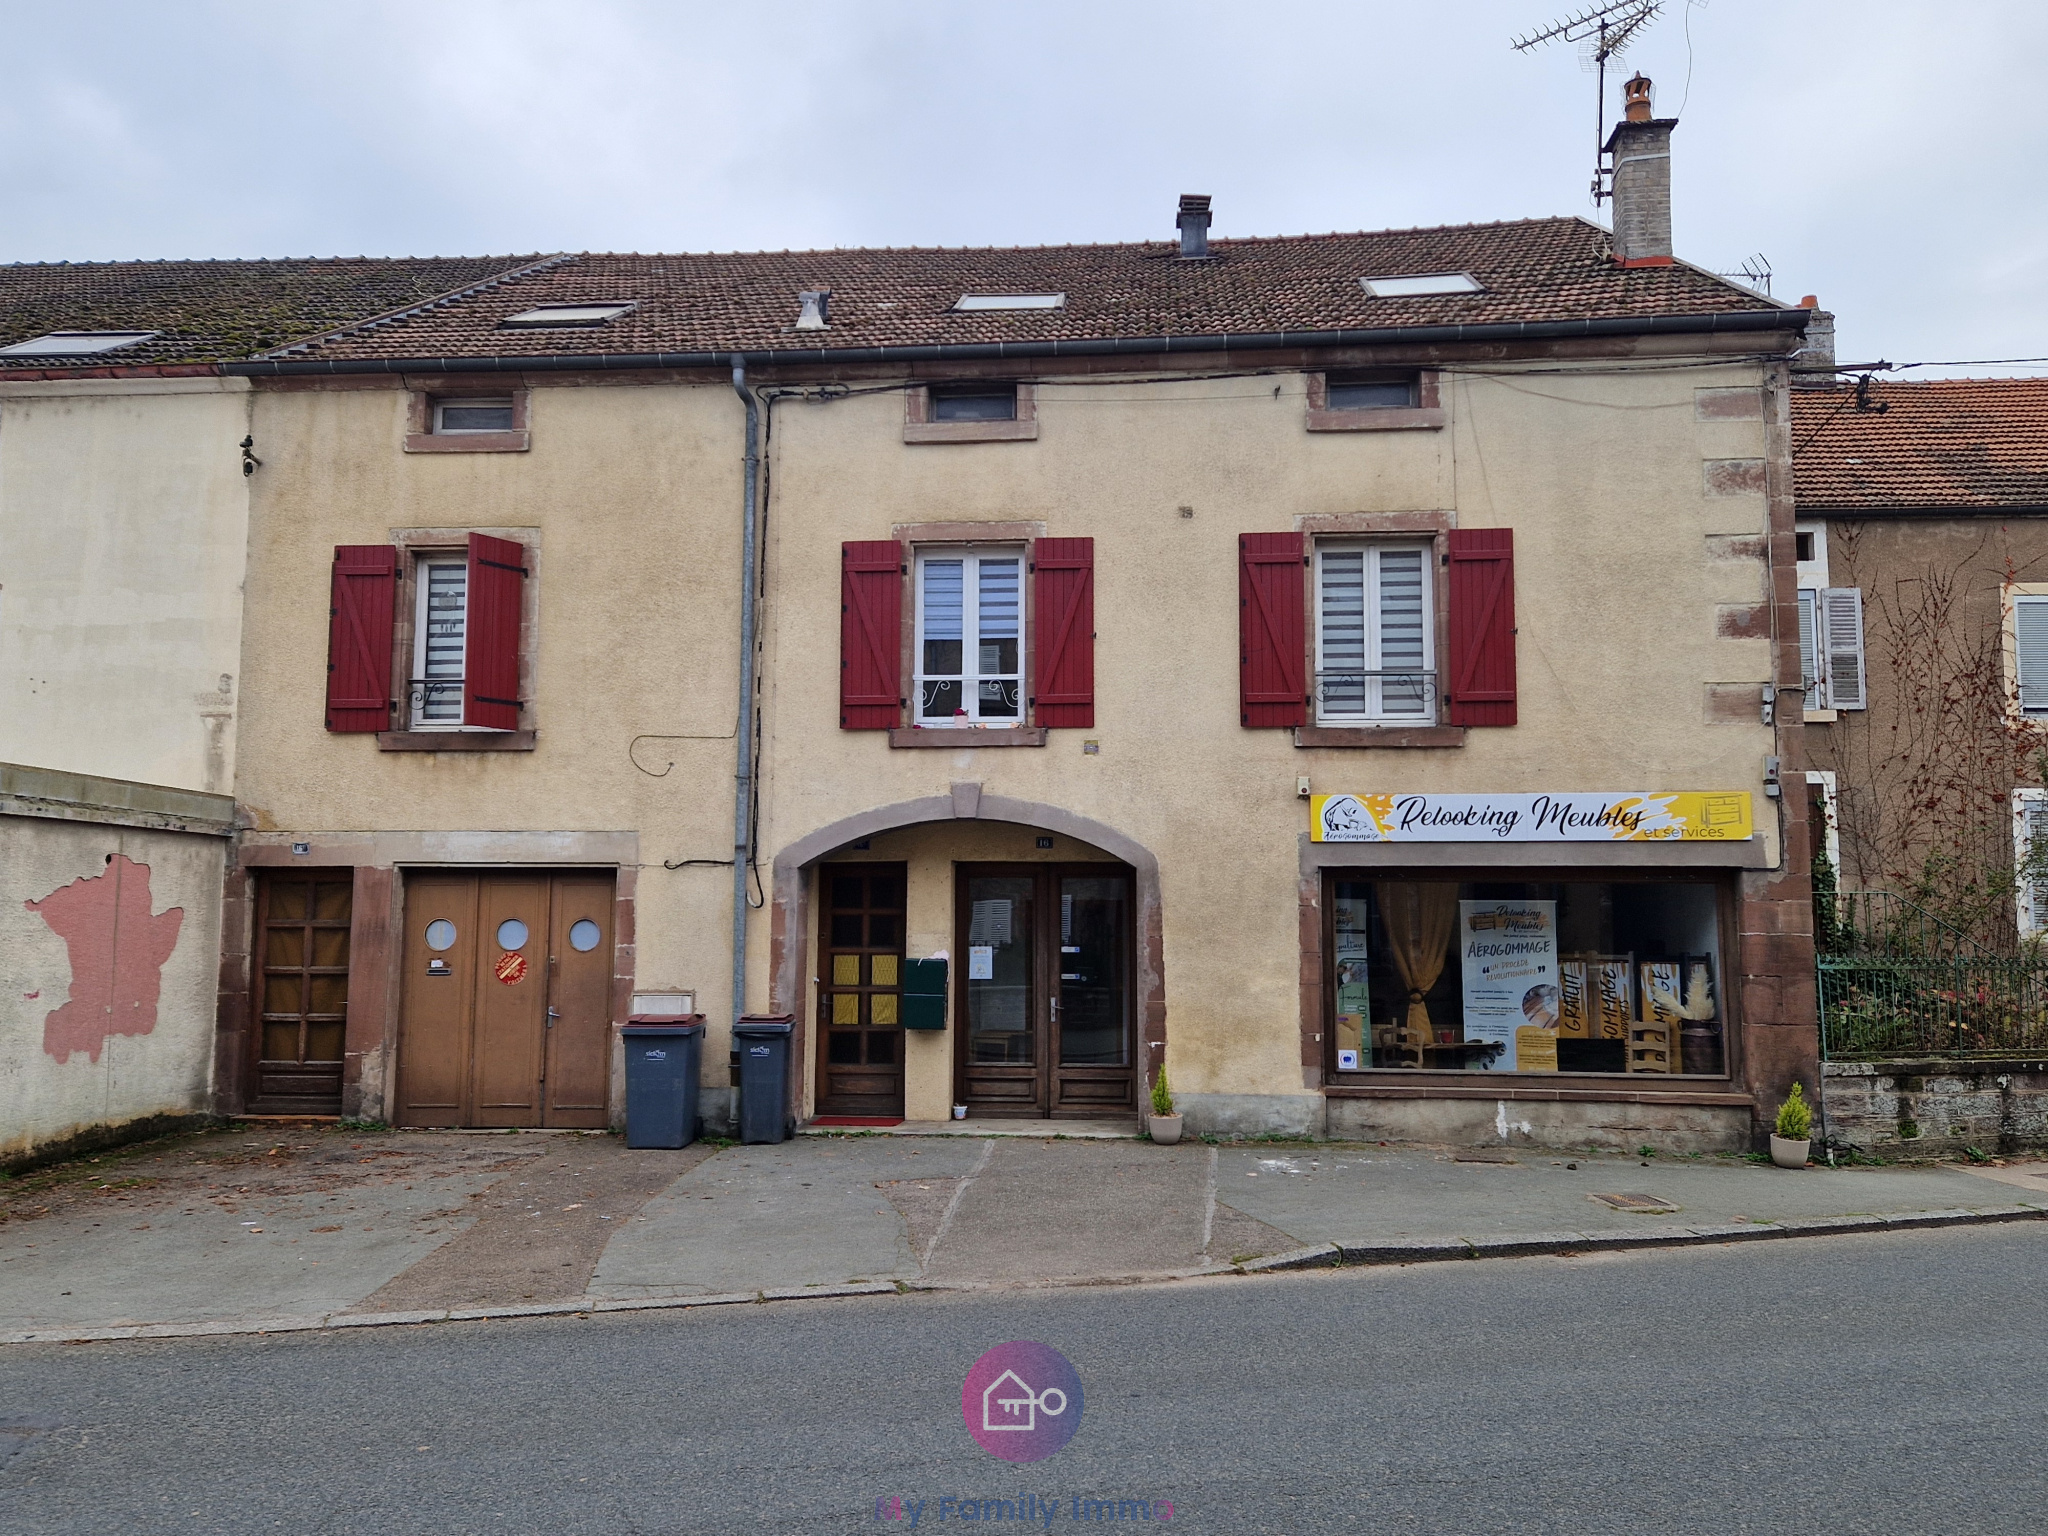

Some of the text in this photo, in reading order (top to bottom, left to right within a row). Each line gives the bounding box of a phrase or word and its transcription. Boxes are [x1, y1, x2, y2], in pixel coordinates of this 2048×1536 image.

[1396, 795, 1646, 838] Relooking Meubles
[1644, 825, 1725, 838] et services
[1467, 940, 1551, 959] AÉROGOMMAGE
[1563, 973, 1582, 1032] GRATUIT
